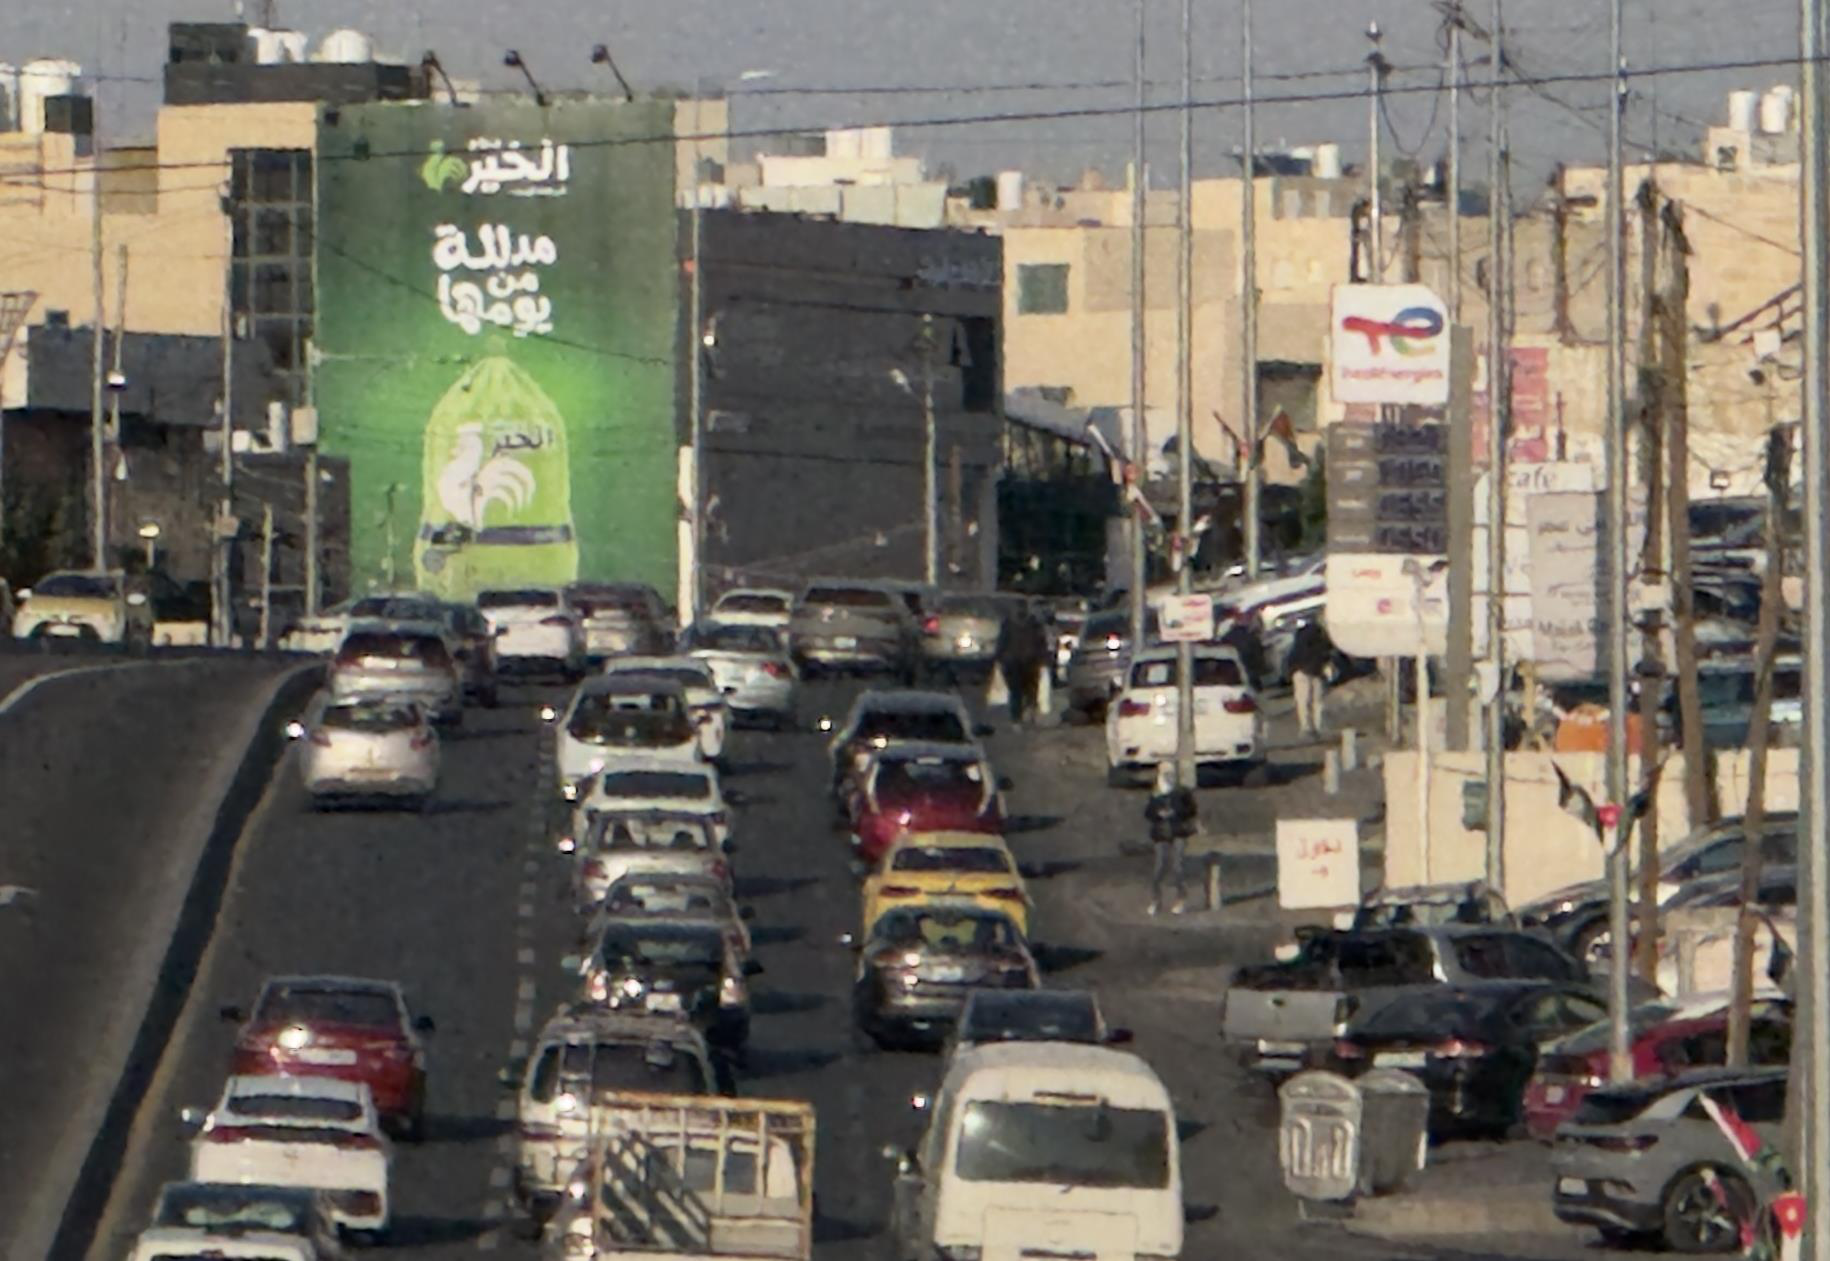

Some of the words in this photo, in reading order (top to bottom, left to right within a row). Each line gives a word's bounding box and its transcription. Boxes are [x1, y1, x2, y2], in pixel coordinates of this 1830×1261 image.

[432, 223, 558, 271] مدللة
[437, 273, 553, 337] يومها
[486, 271, 540, 298] من
